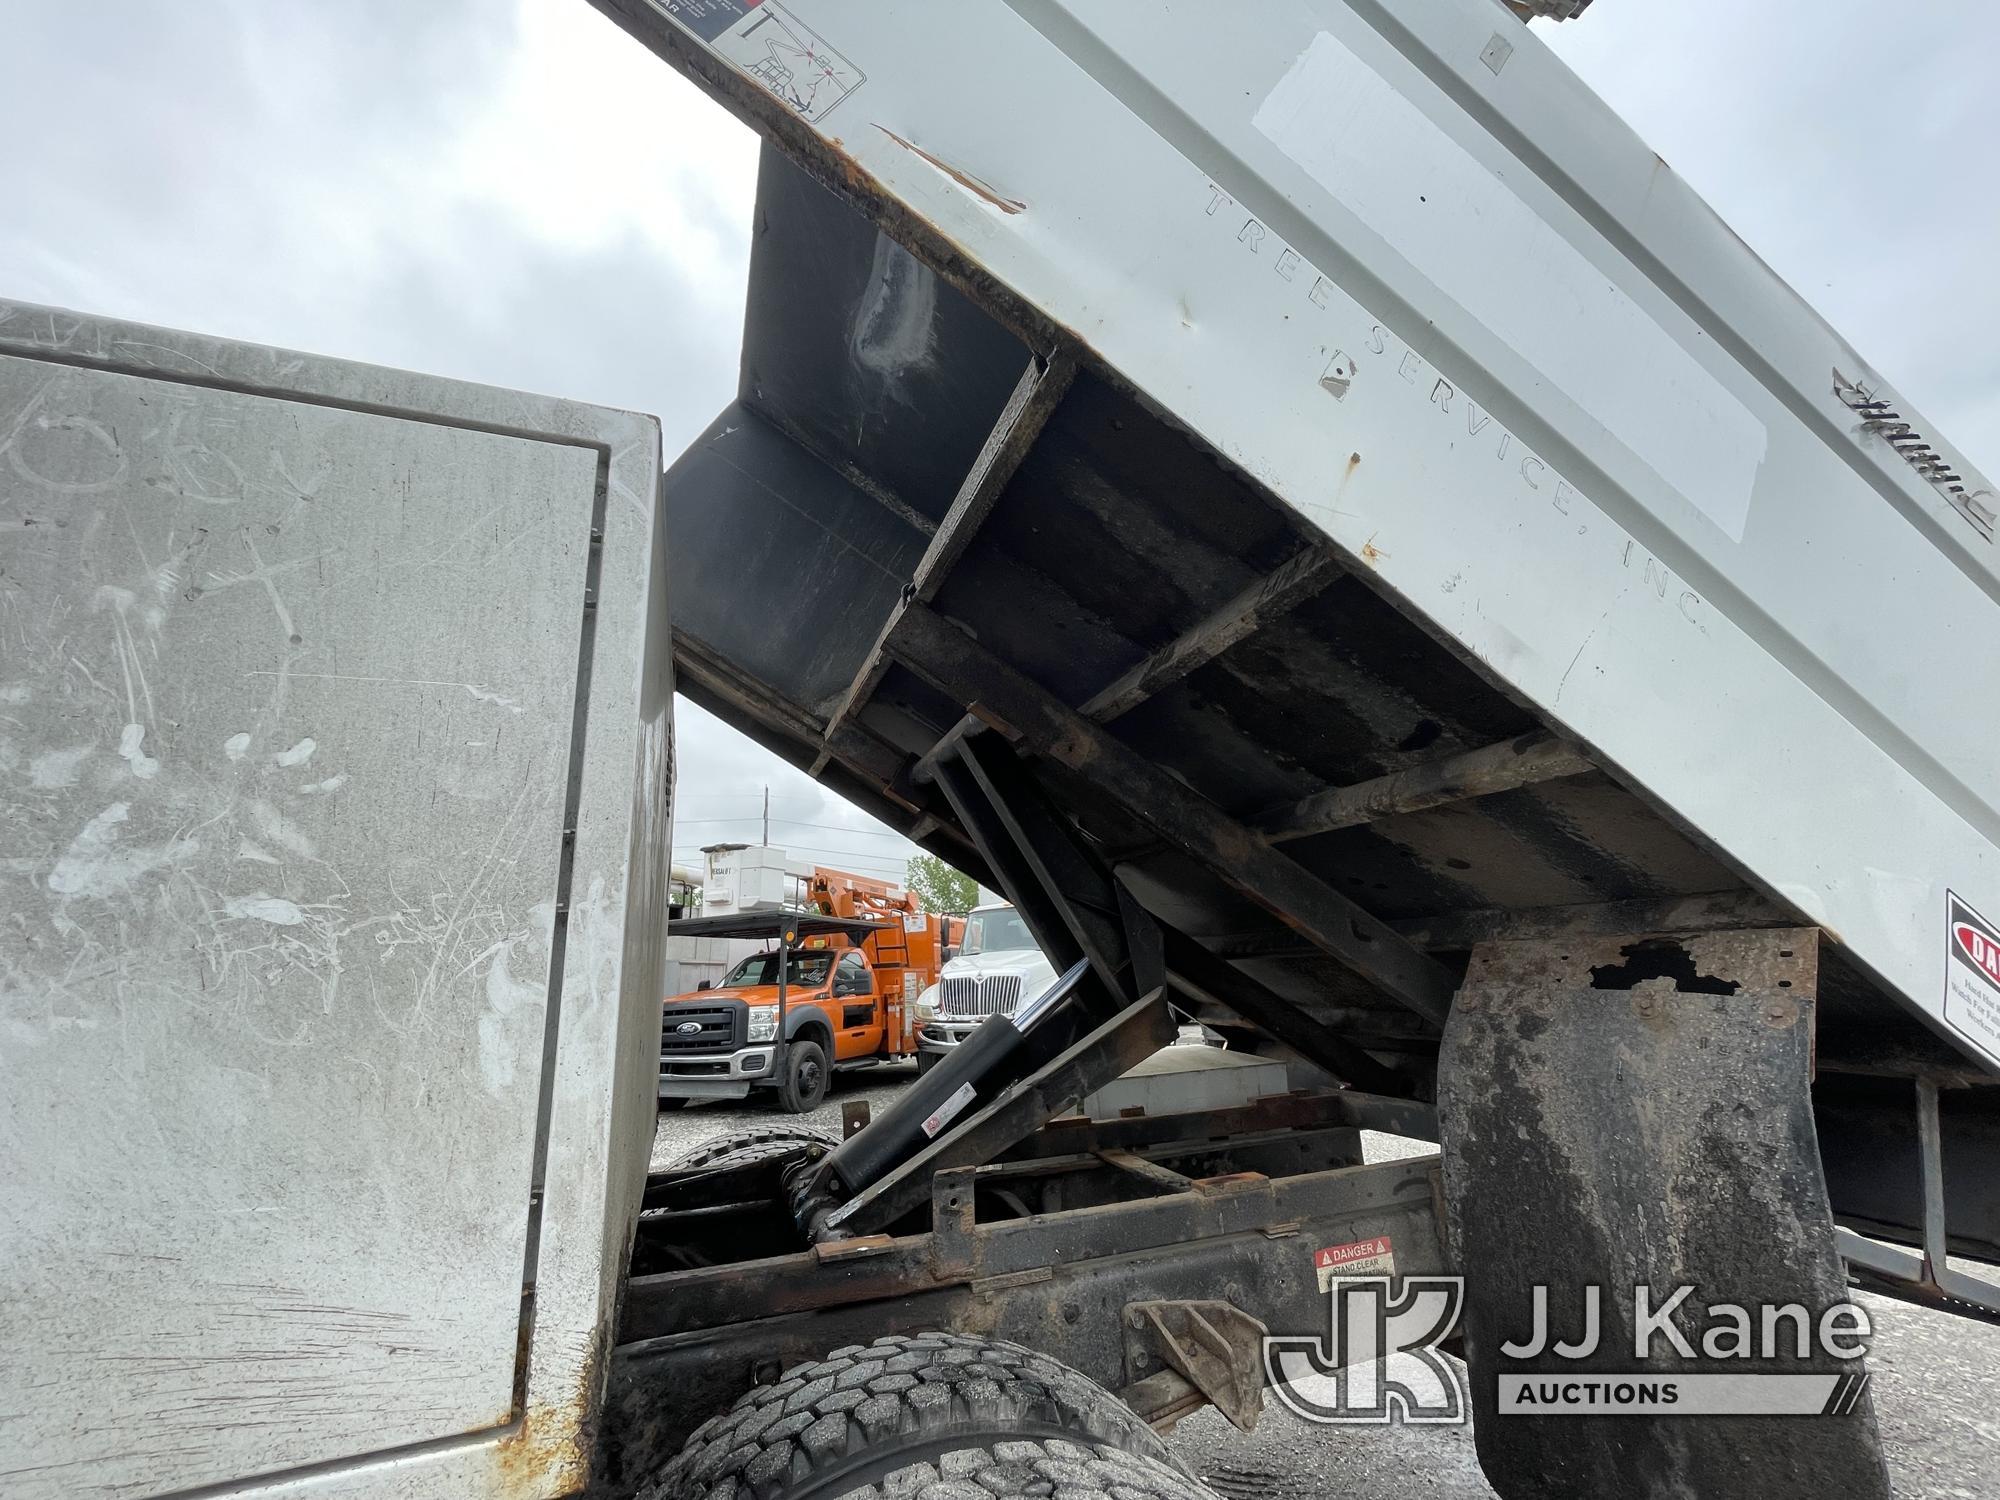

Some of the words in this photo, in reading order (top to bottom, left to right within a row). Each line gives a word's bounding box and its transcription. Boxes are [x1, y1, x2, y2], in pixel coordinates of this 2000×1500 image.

[1203, 184, 1334, 311] TREE
[1333, 1243, 1375, 1261] DANGER
[1333, 1264, 1355, 1275] STAND
[1356, 1258, 1379, 1270] CLEAR
